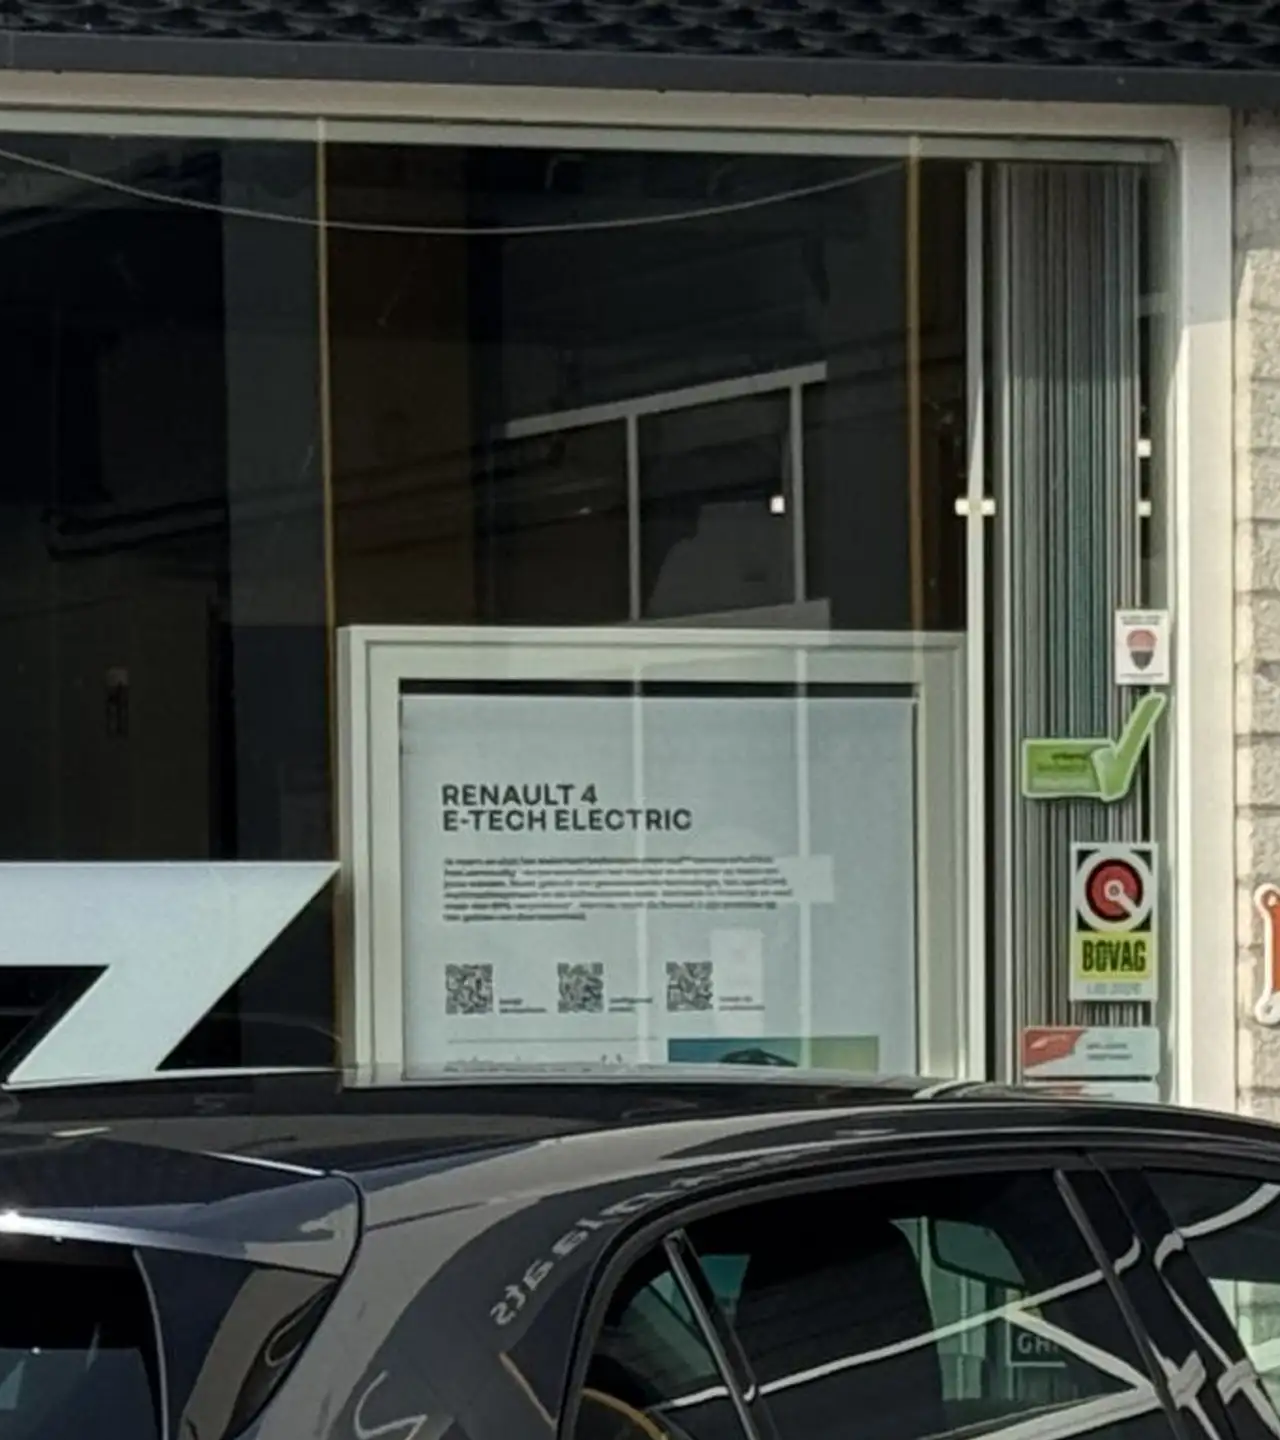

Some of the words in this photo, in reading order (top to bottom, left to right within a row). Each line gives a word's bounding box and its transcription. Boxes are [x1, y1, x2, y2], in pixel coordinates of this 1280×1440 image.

[441, 784, 575, 806] RENAULT
[580, 784, 598, 806] 4
[442, 808, 546, 831] E-TECH
[554, 808, 692, 831] ELECTRIC
[1082, 940, 1146, 972] BOVAG
